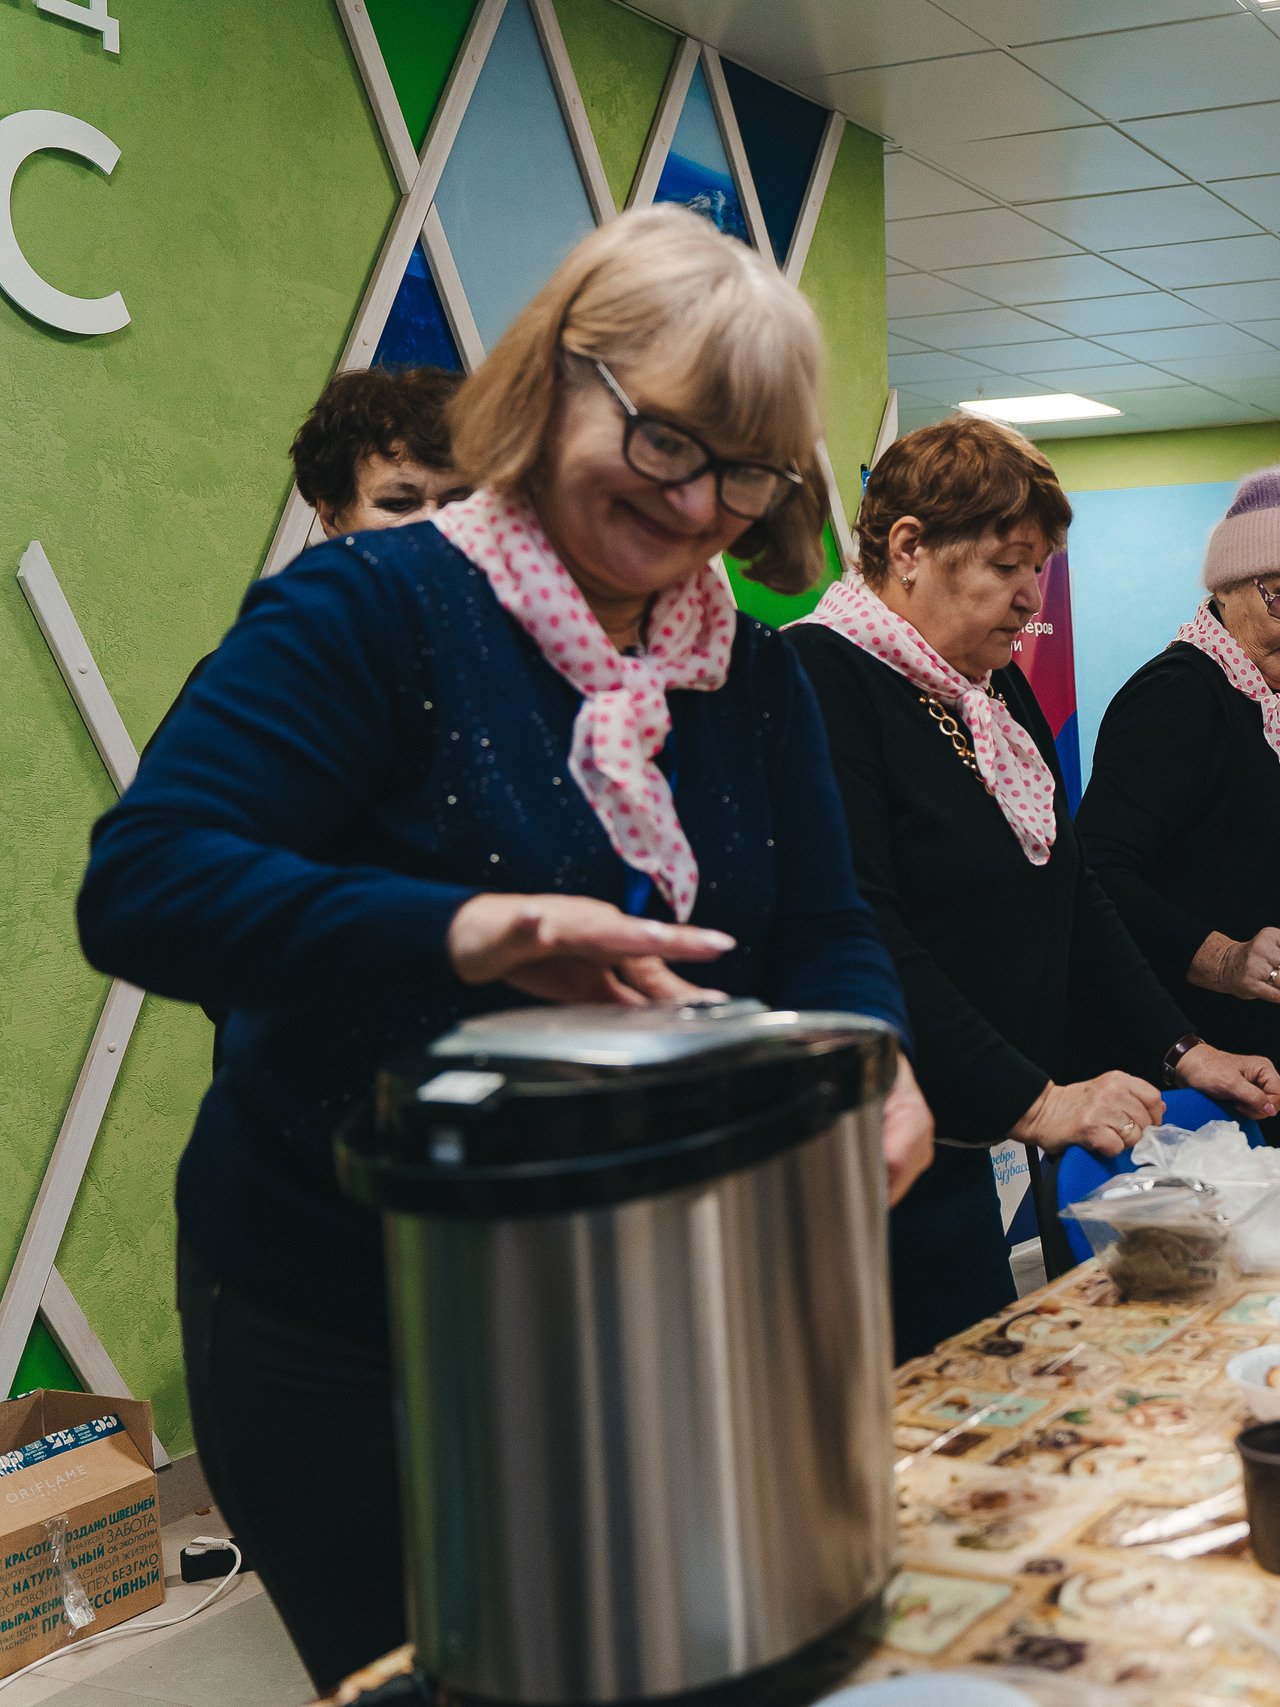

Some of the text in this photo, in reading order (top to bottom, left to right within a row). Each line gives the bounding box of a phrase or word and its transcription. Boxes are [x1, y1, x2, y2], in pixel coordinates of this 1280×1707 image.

[6, 1465, 87, 1503] ORIFLAME
[65, 1517, 108, 1543] ОЗДАНО
[108, 1494, 156, 1525] ШВЕЦИЕЙ
[106, 1513, 157, 1543] ЗАБОТА
[13, 1542, 105, 1596] НАТУРАЬНЫЙ
